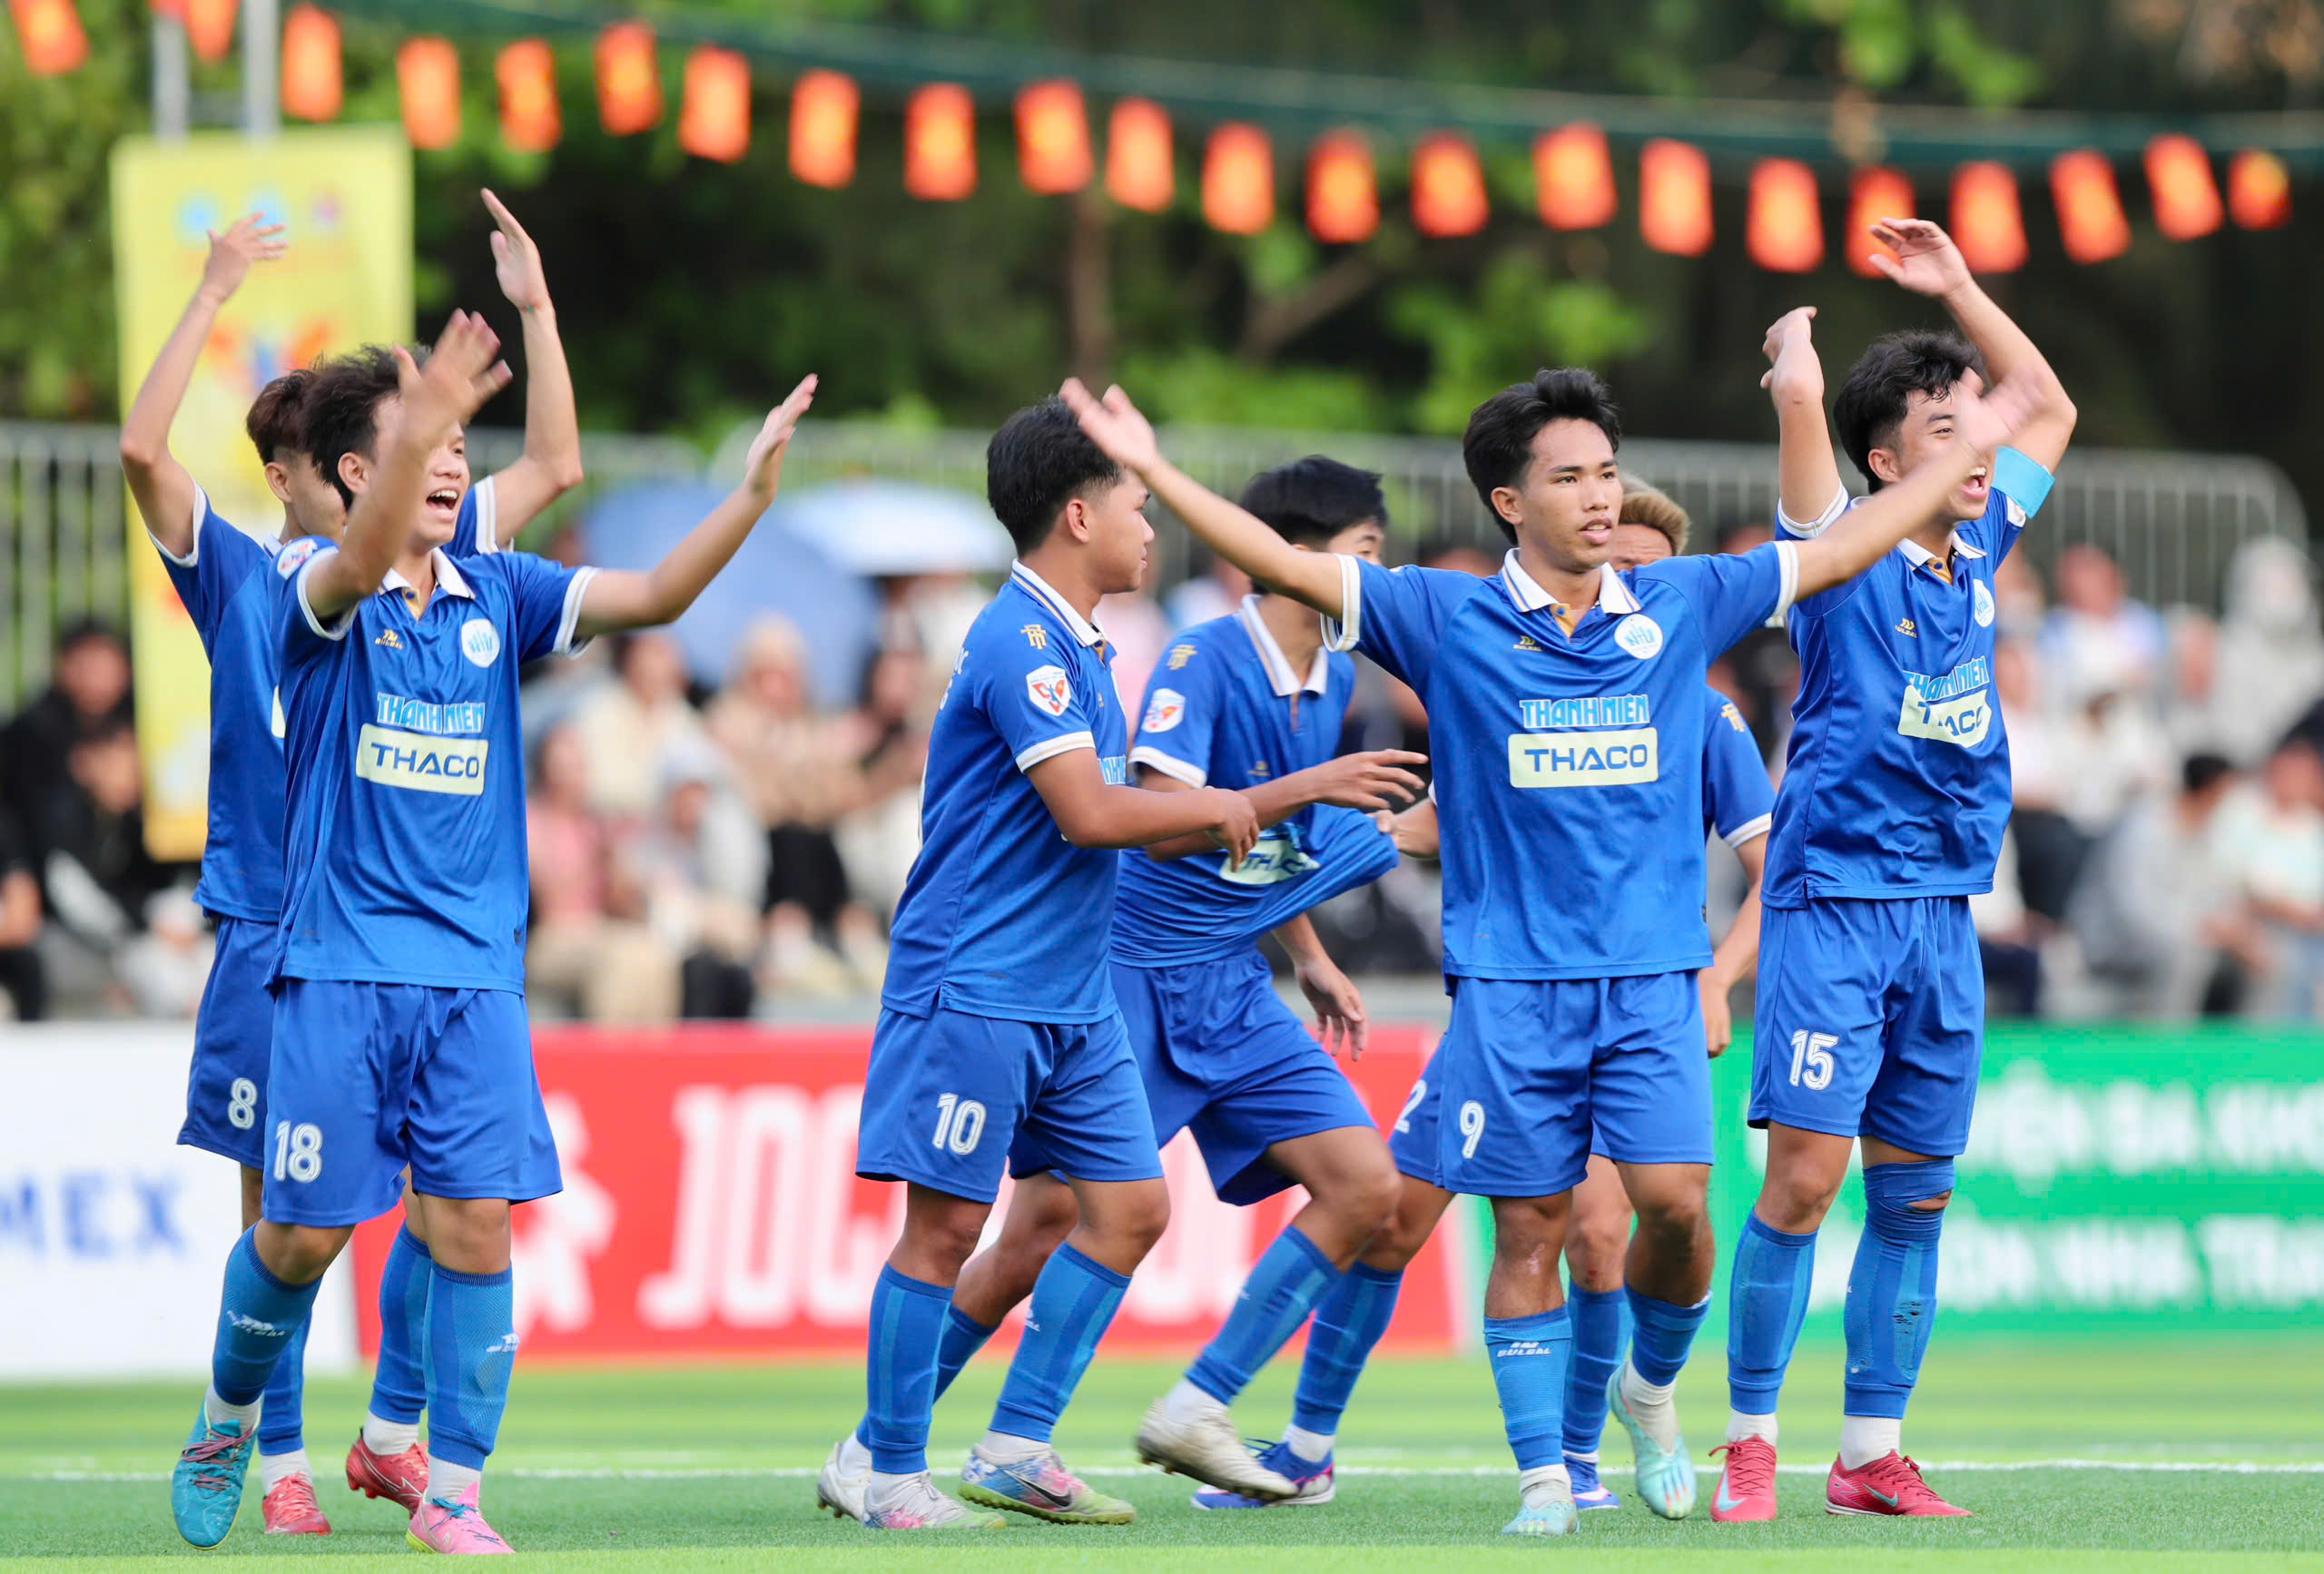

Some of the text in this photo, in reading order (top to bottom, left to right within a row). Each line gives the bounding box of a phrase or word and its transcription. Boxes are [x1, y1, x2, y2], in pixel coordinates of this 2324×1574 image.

[1519, 694, 1650, 729] THANH NIÊN
[1917, 702, 1984, 736] TAC
[370, 742, 480, 779] THACO
[1524, 743, 1648, 772] THACO
[1788, 1028, 1839, 1091] 15
[228, 1077, 259, 1131] 8
[932, 1092, 987, 1156] 10
[1459, 1099, 1486, 1160] 9
[273, 1120, 323, 1184] 18
